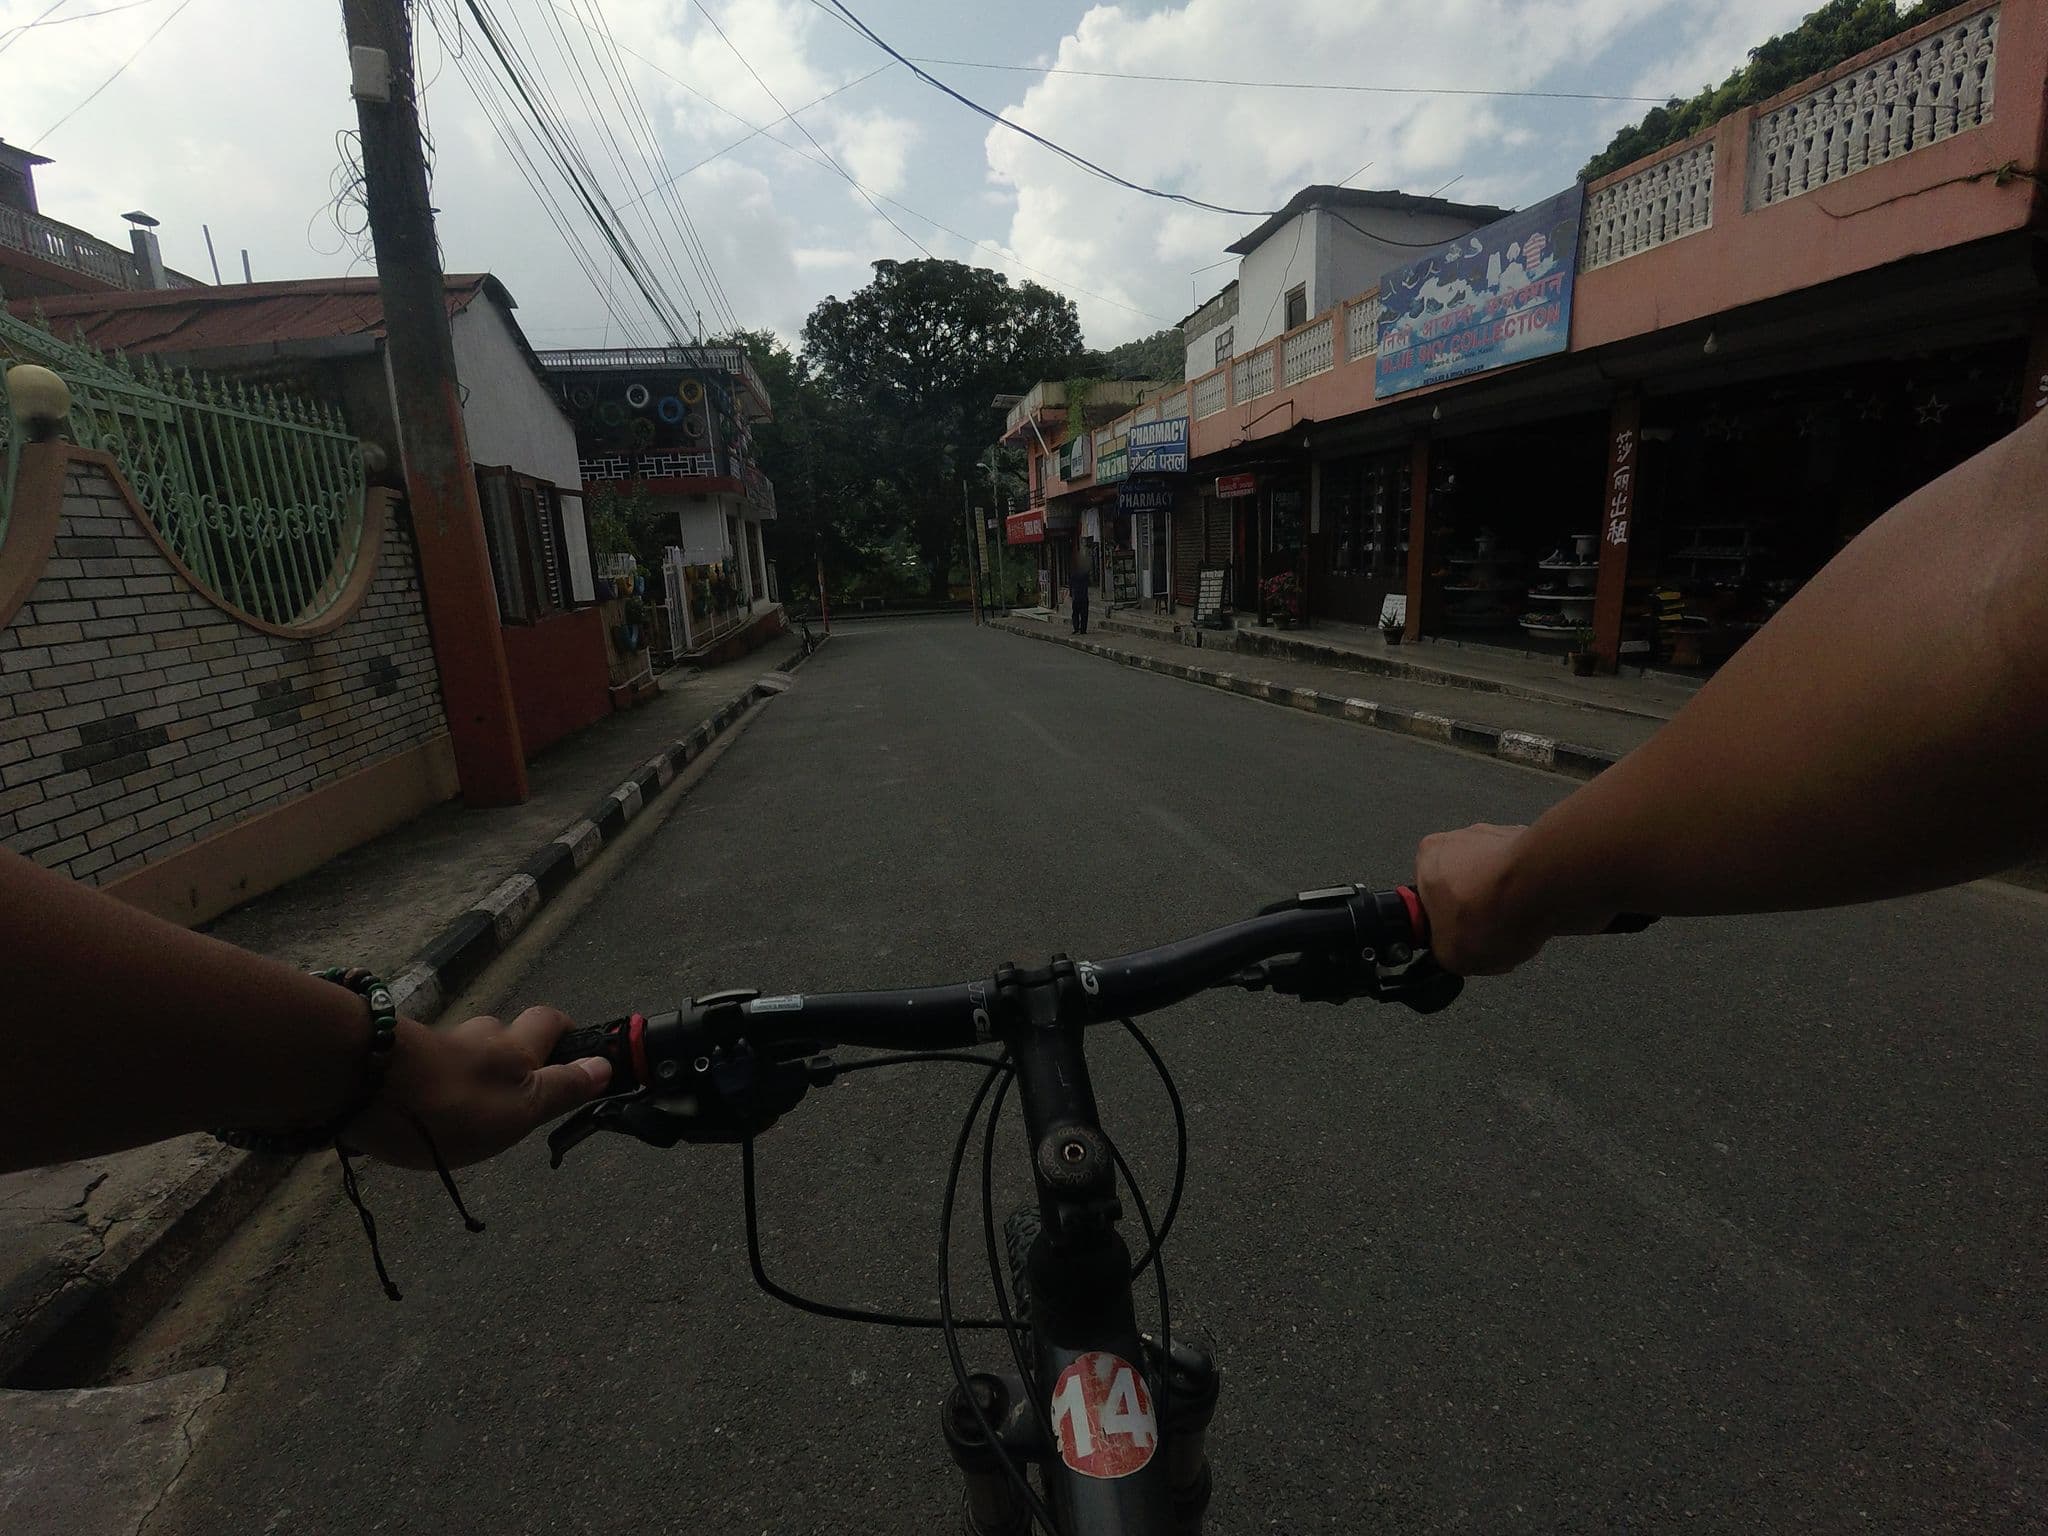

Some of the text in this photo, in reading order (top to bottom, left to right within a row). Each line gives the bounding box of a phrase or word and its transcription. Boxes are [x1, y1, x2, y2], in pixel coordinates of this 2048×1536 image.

[1451, 302, 1561, 354] COLLECTION
[1130, 420, 1187, 446] PHARMACY
[1160, 453, 1186, 472] पसल
[1119, 491, 1174, 509] PHARMACY
[1052, 1368, 1154, 1458] 14
